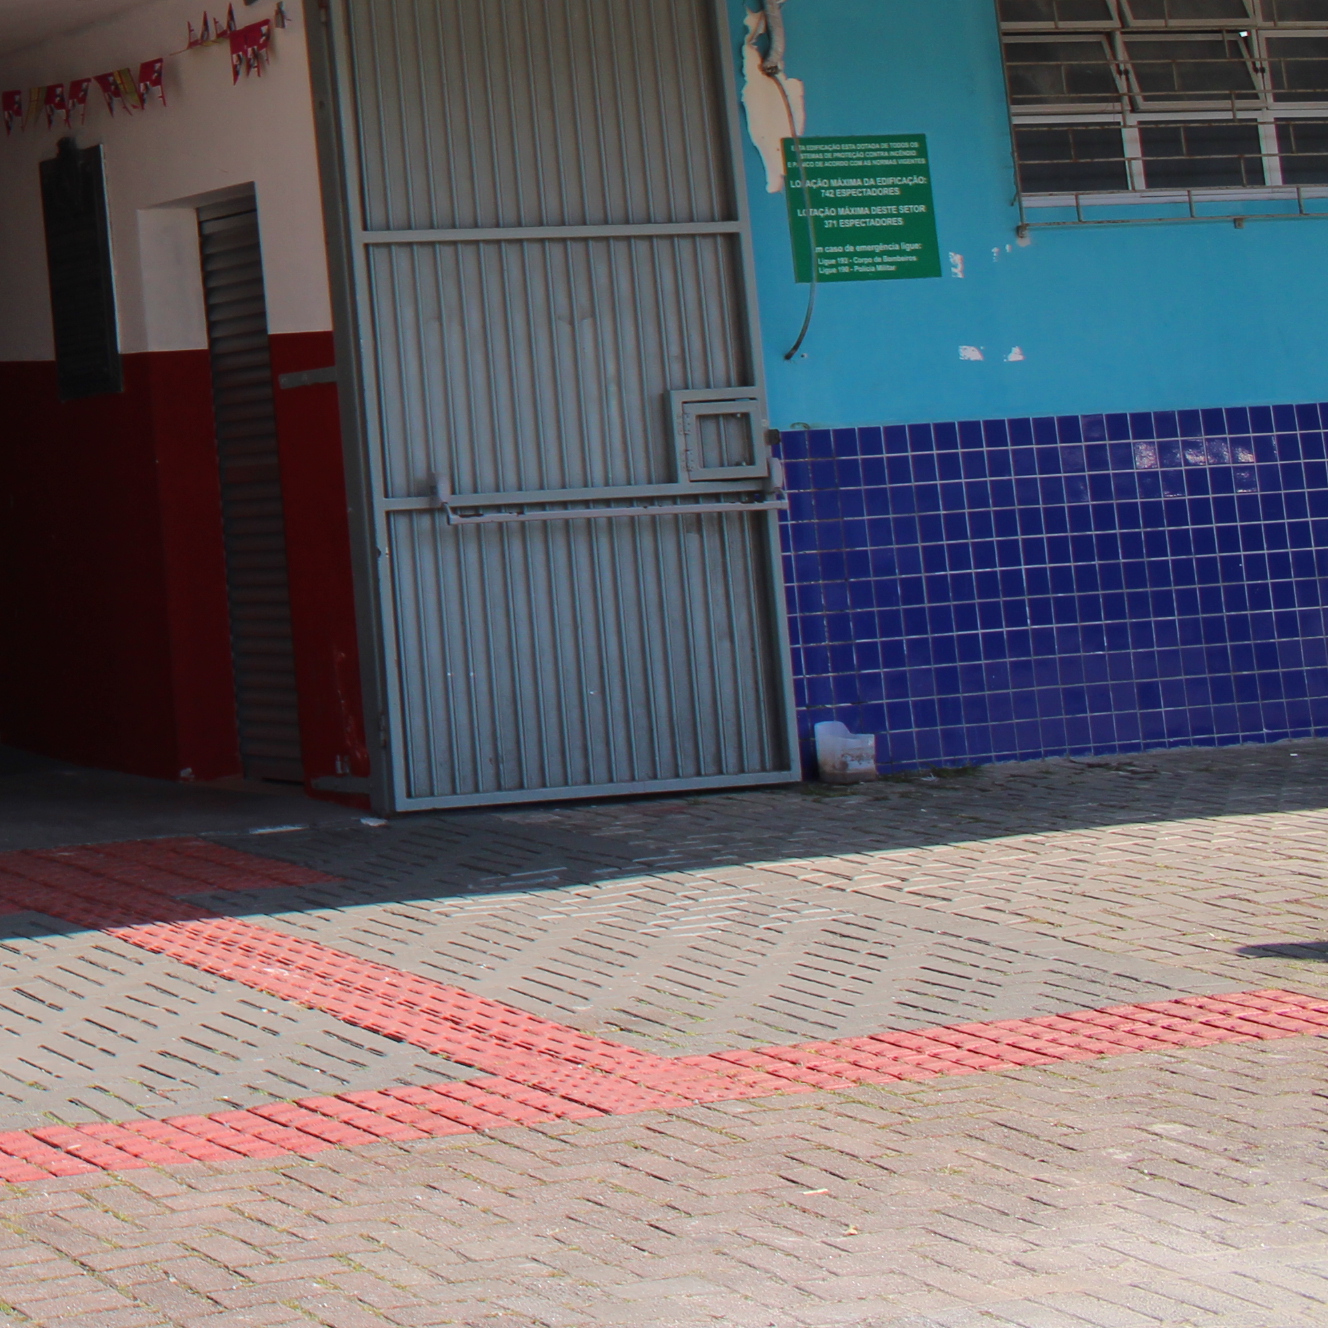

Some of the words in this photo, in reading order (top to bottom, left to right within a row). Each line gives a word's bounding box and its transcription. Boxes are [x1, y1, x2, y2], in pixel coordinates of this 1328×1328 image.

[806, 143, 841, 151] EDIFICAÇÃO
[833, 151, 864, 159] PROTEÇÃO
[790, 177, 829, 189] LOAÇÃO
[830, 177, 863, 187] MÁXIMA
[863, 177, 876, 186] DA
[876, 175, 928, 186] EDIFICAÇÃO:
[820, 189, 835, 198] 742
[836, 187, 901, 197] ESPECTADORES
[837, 206, 870, 215] MÁXIMA
[871, 205, 898, 214] DESTE
[898, 204, 927, 213] SETOR
[824, 219, 838, 228] 371
[839, 217, 904, 227] ESPECTADORES
[844, 244, 855, 252] de
[855, 242, 900, 253] emergência
[901, 242, 923, 252] ligue:
[817, 257, 837, 266] Ligue
[853, 256, 873, 264] Corpo
[882, 255, 918, 263] Bombeiros
[818, 266, 837, 275] Ligue
